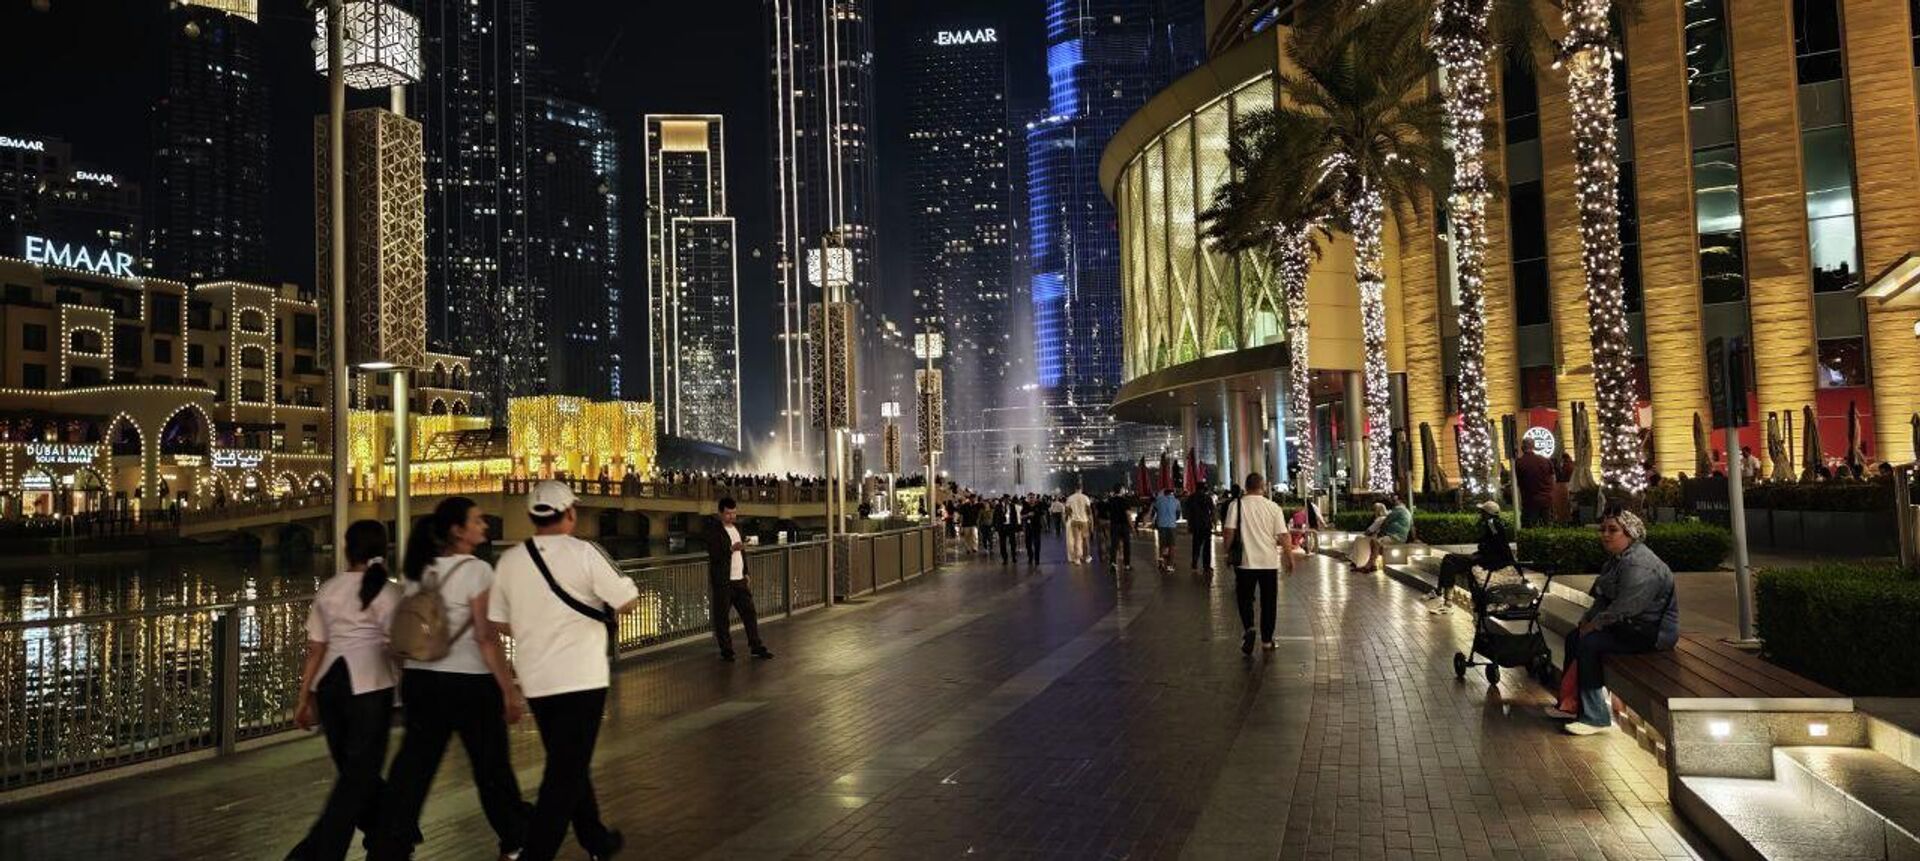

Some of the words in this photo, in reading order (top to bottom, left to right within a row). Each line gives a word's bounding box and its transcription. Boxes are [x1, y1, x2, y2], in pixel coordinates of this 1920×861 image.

[938, 28, 997, 45] EMAAR
[0, 136, 44, 151] EMAAR
[76, 171, 113, 183] EMAAR
[26, 236, 135, 277] EMAAR
[27, 445, 65, 456] DUBAI
[68, 446, 100, 458] MALL
